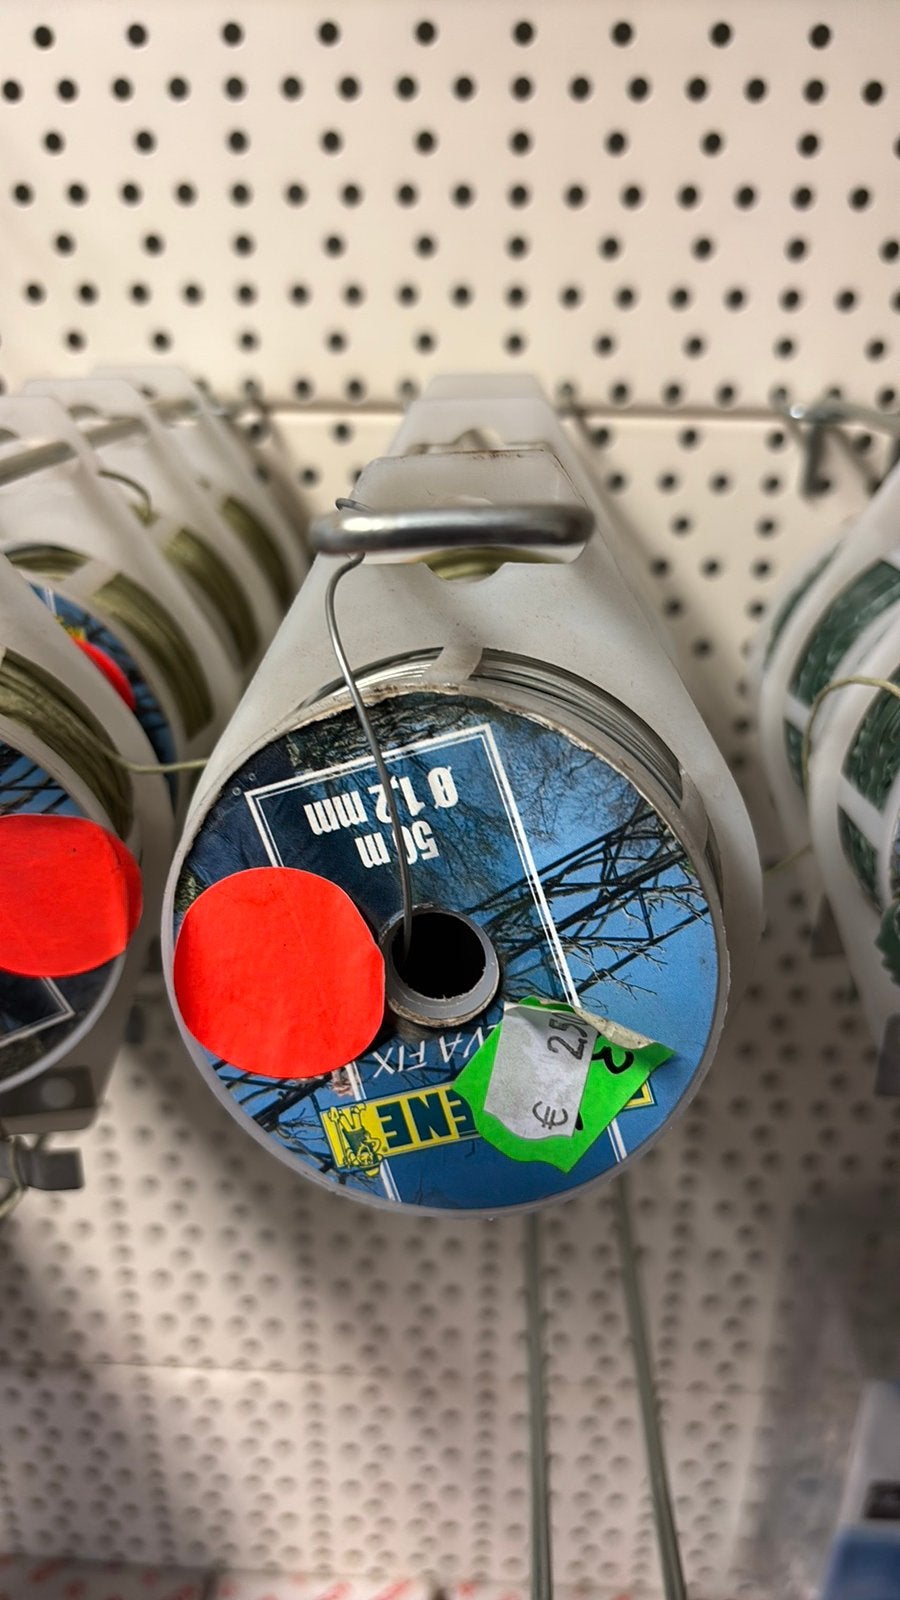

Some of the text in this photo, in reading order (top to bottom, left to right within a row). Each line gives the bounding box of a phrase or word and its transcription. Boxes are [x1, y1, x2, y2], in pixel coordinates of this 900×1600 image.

[303, 790, 369, 836] mm
[368, 775, 426, 824] 1,2
[354, 820, 440, 868] 50 m
[372, 1024, 499, 1078] VA FIX
[376, 1089, 478, 1149] ENE
